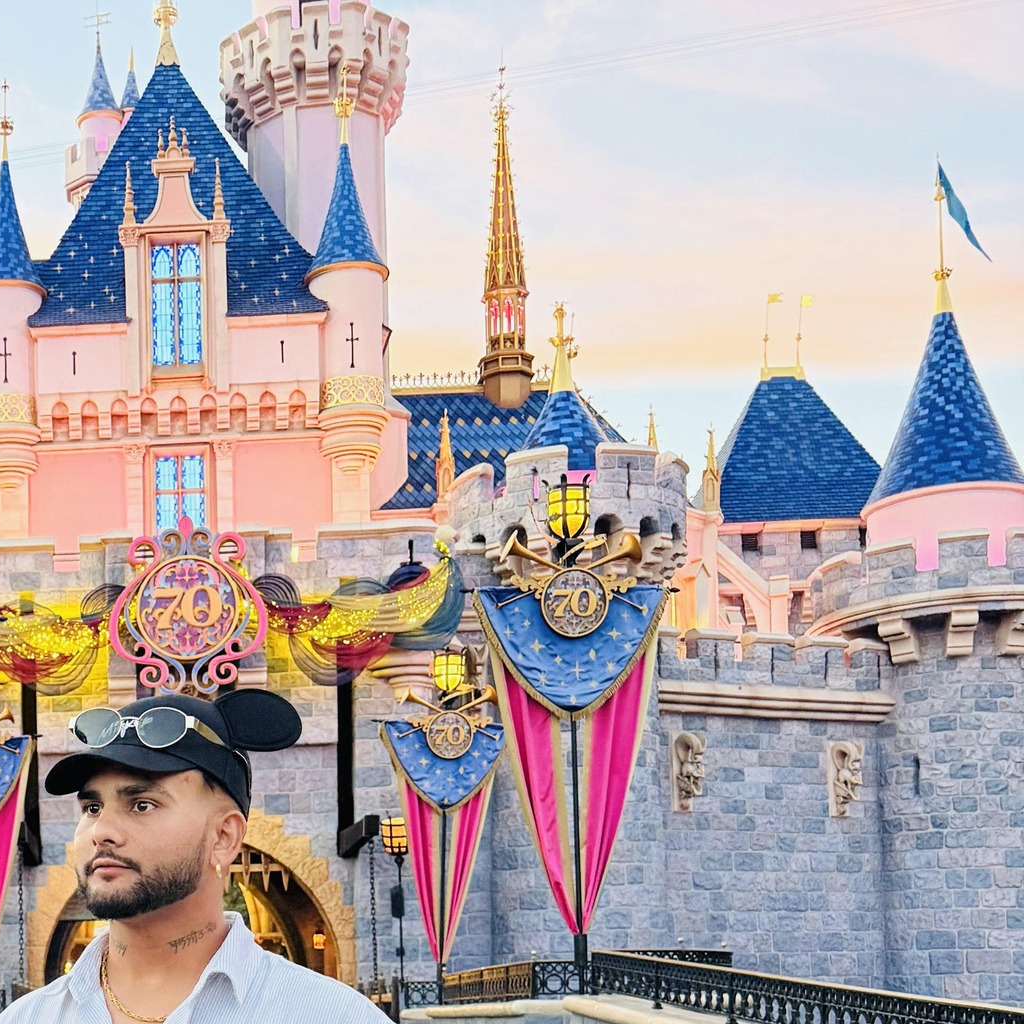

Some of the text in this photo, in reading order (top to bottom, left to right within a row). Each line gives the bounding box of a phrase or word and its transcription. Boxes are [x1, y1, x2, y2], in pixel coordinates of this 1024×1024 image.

[153, 586, 223, 631] 70
[551, 588, 598, 618] 70
[434, 725, 466, 746] 70
